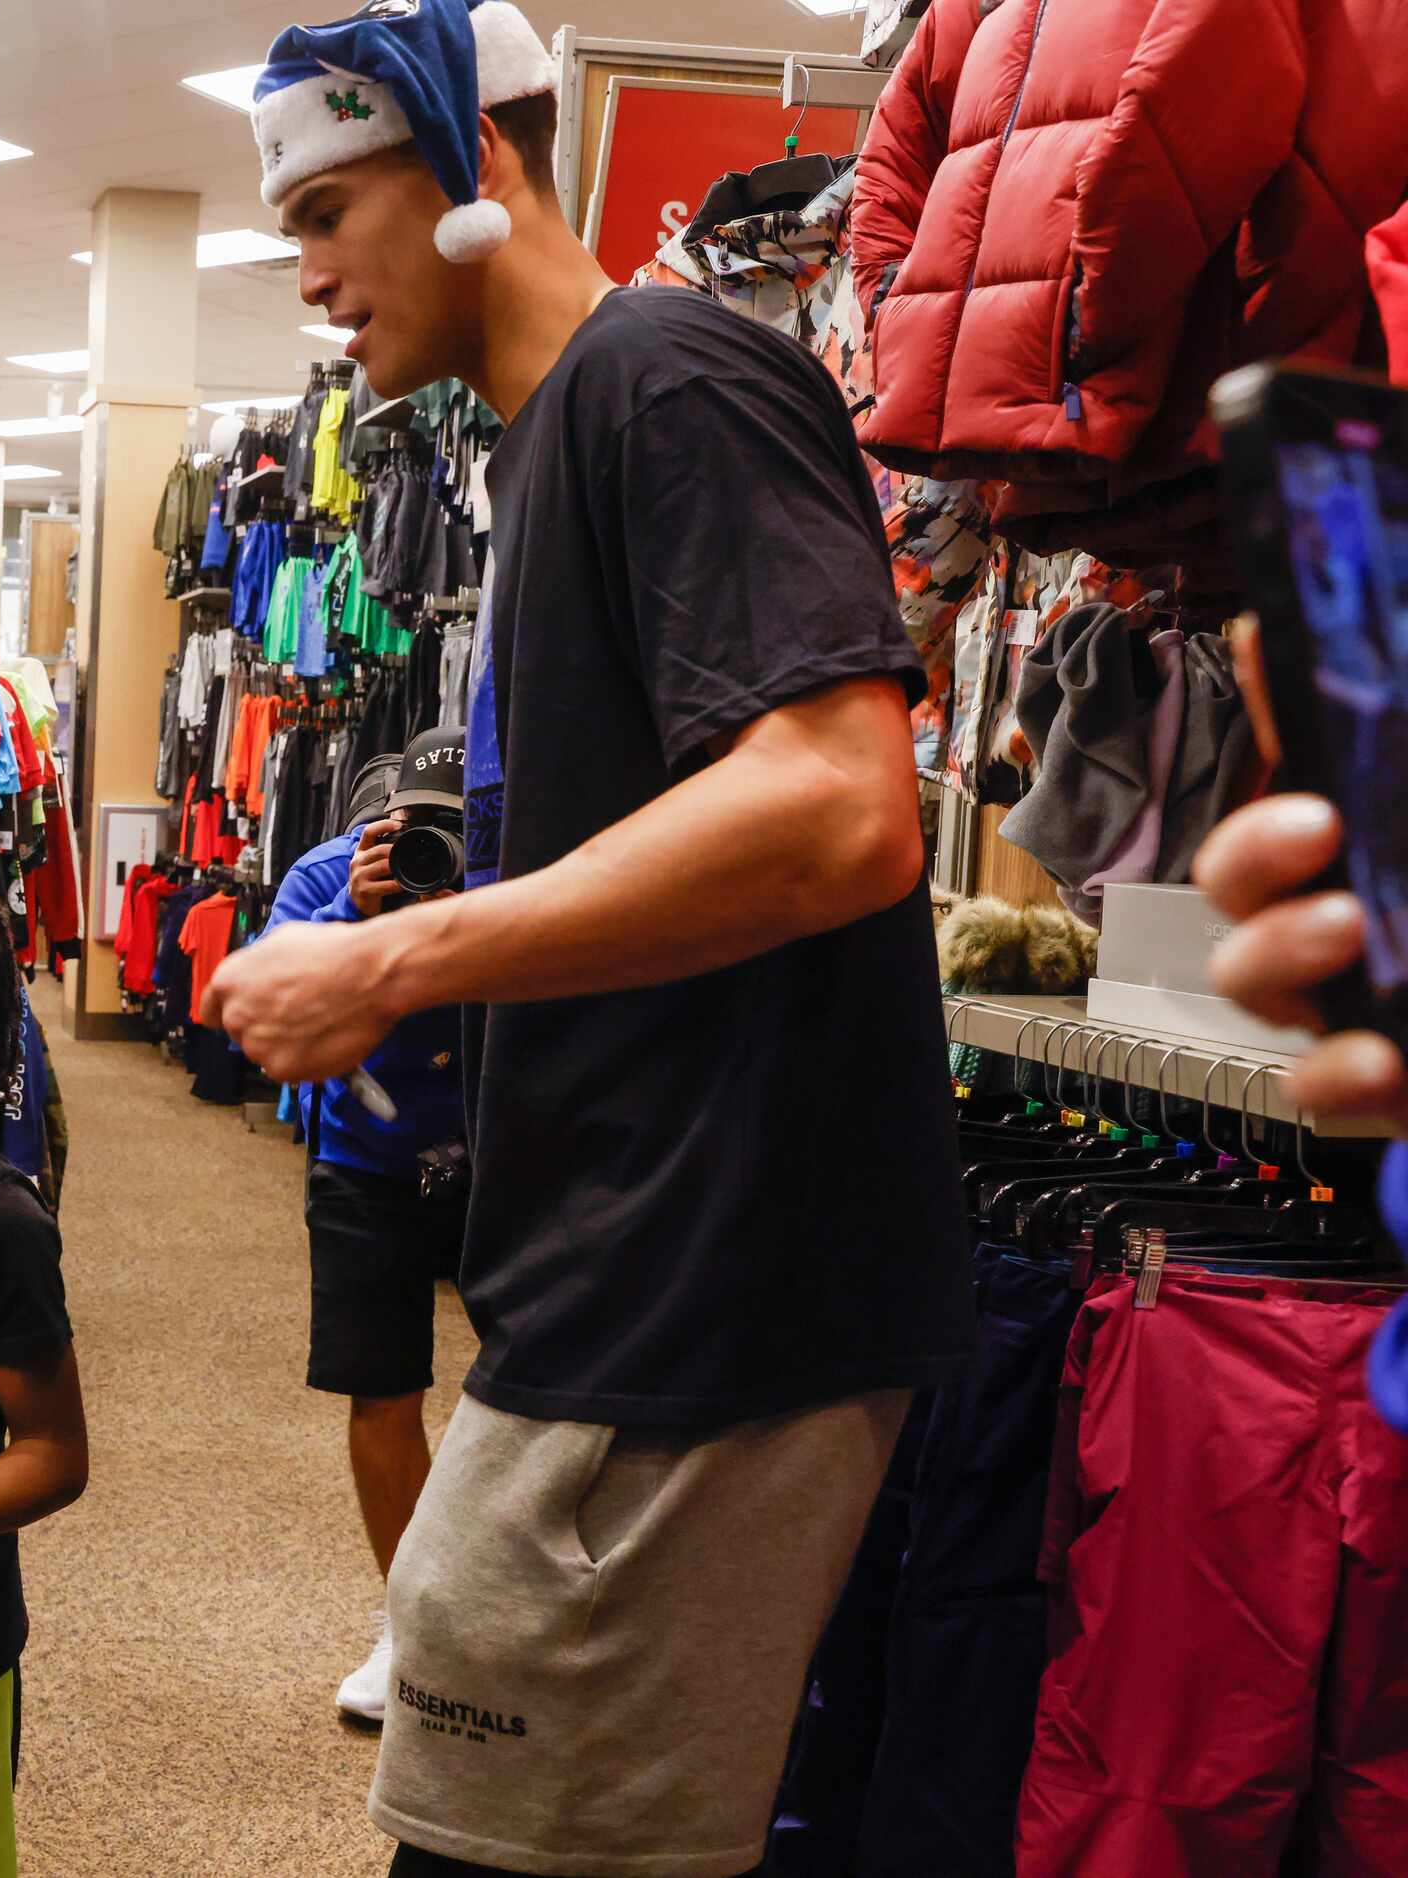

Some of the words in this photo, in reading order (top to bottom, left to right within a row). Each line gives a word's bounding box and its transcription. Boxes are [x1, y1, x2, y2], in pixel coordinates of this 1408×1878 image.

[656, 201, 688, 246] S
[415, 747, 465, 771] LLAS
[398, 1680, 527, 1737] ESSENTIALS
